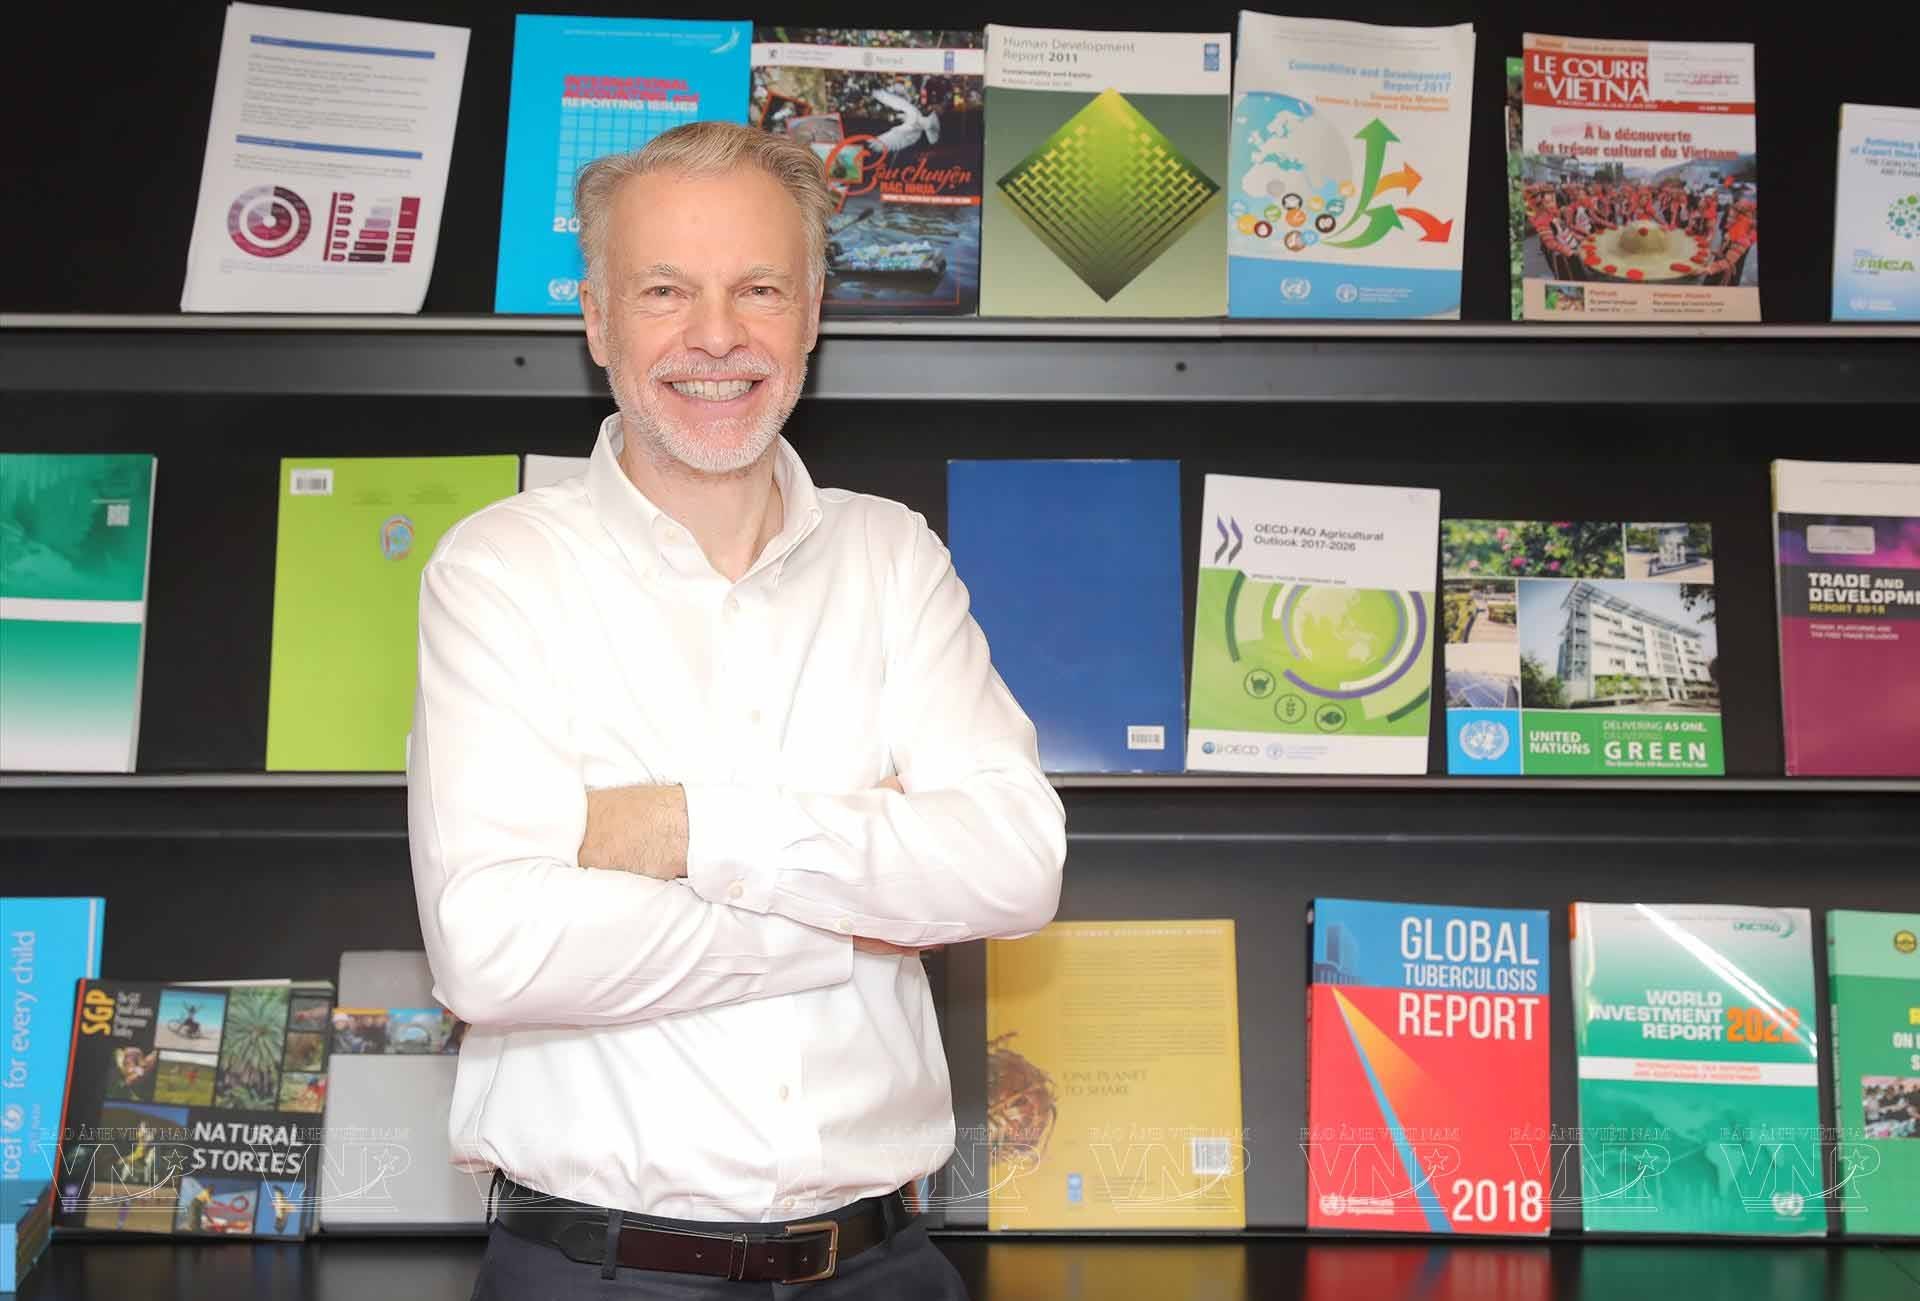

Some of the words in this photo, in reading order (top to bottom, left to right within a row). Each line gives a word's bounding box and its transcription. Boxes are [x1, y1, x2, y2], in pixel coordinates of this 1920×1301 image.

[1003, 36, 1048, 49] Human
[1052, 39, 1136, 54] Development
[1003, 51, 1045, 64] Report
[1048, 53, 1079, 64] 2011
[1533, 54, 1556, 75] LE
[1289, 60, 1356, 76] Commodities
[1360, 66, 1379, 77] and
[1383, 68, 1453, 83] Development
[563, 75, 689, 90] INTERNATIONAL
[1383, 81, 1422, 92] Report
[1424, 82, 1451, 92] 2017
[1545, 75, 1650, 102] VIETNA
[561, 97, 645, 111] REPORTING
[648, 101, 698, 112] ISSUES
[1598, 127, 1611, 140] la
[1614, 128, 1692, 142] découverte
[1538, 141, 1554, 154] du
[1558, 141, 1598, 156] trésor
[1603, 144, 1657, 158] culturel
[1660, 145, 1678, 158] du
[1681, 147, 1739, 160] Vietnam
[552, 216, 580, 232] 20
[1254, 523, 1316, 538] OECD-FAO
[1319, 529, 1384, 542] Agricultural
[1254, 535, 1297, 548] Outlook
[1301, 538, 1357, 552] 2017-2026
[1808, 573, 1870, 588] TRADE
[1874, 579, 1904, 588] AND
[1809, 603, 1851, 613] REPORT
[1603, 720, 1663, 732] DELIVERING
[1664, 722, 1679, 731] AS
[1530, 730, 1581, 743] UNITED
[1530, 742, 1591, 755] NATIONS
[1604, 741, 1706, 761] GREEN
[1400, 917, 1540, 965] GLOBAL
[11, 930, 36, 985] child
[1403, 963, 1538, 991] TUBERCULOSIS
[1645, 989, 1722, 1006] WORLD
[11, 991, 37, 1052] every
[82, 989, 115, 1035] SGP
[1399, 993, 1540, 1040] REPORT
[1593, 1004, 1723, 1023] NVESTMENT
[1642, 1022, 1723, 1041] REPORT
[1892, 1031, 1913, 1049] ON
[5, 1059, 27, 1089] for
[1063, 1071, 1092, 1083] ONE
[1095, 1069, 1147, 1083] PLANET
[1064, 1085, 1083, 1096] TO
[1087, 1085, 1130, 1096] SHARE
[193, 1121, 303, 1146] NATURAL
[191, 1149, 301, 1173] STORIES
[1452, 1178, 1543, 1222] 2018
